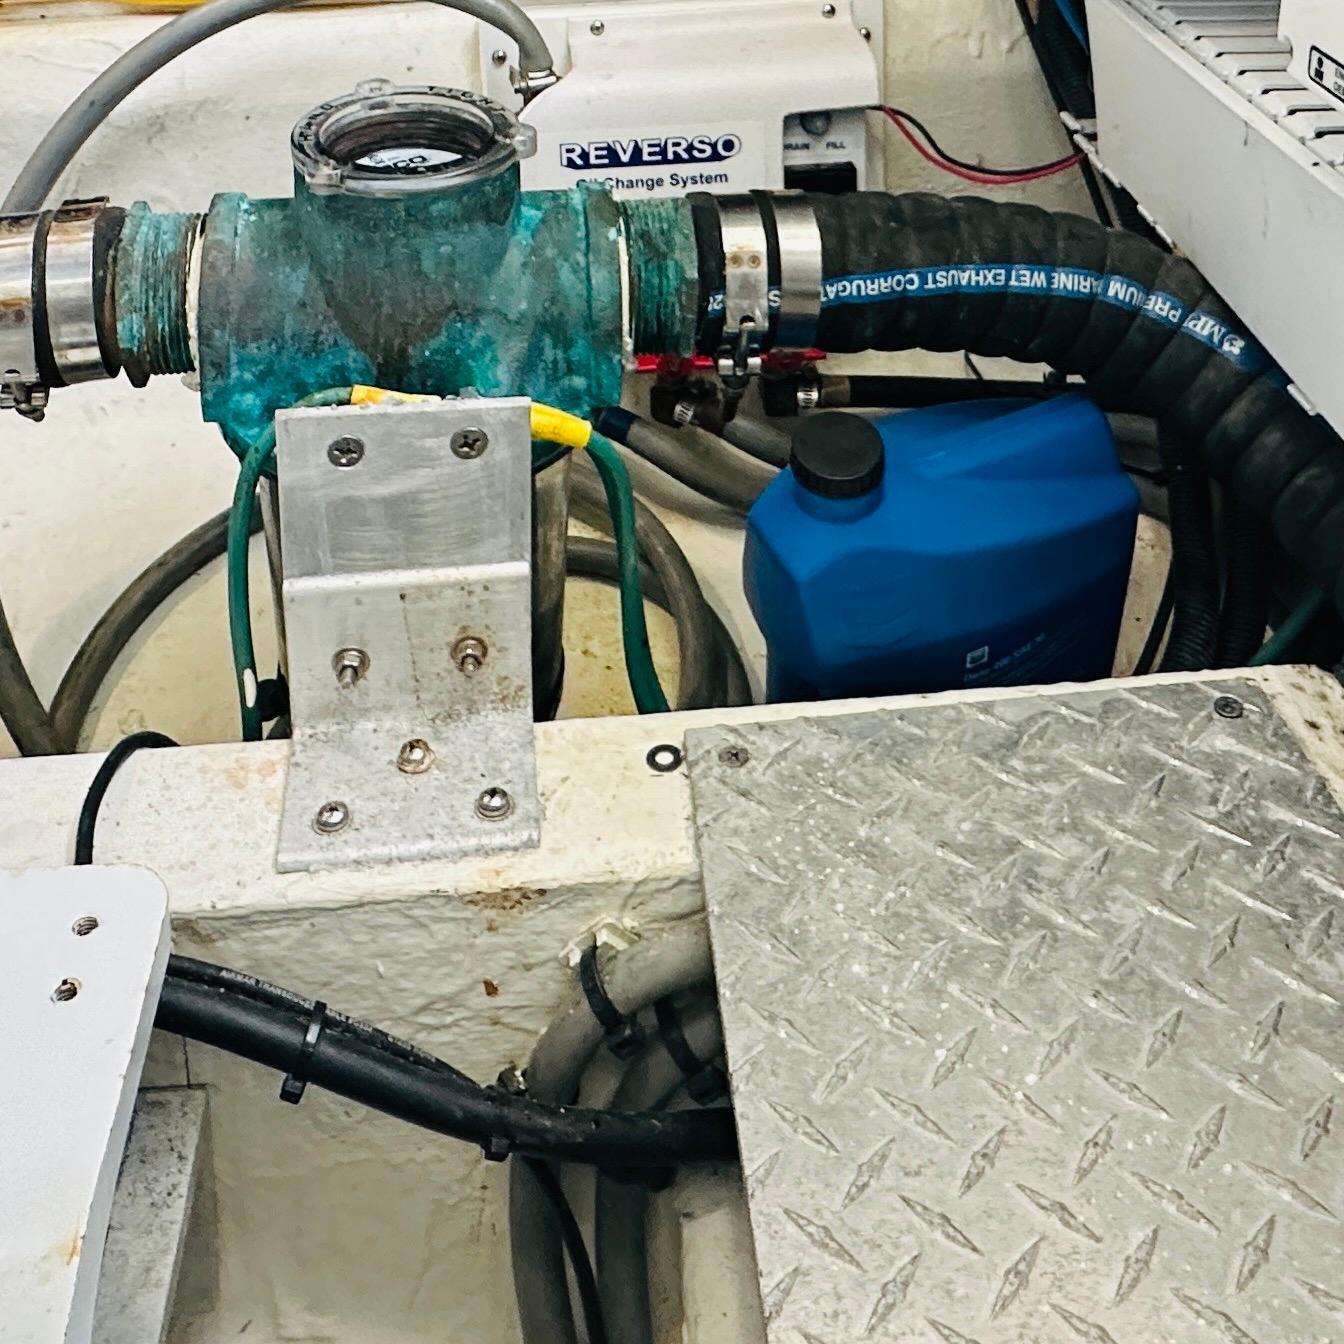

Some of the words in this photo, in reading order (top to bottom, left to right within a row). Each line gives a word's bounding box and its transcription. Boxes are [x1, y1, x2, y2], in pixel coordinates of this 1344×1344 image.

[560, 134, 742, 170] REVERSO
[669, 171, 729, 188] System
[821, 272, 920, 303] CORRUGAT
[925, 268, 1007, 291] EXHAUST
[1010, 268, 1047, 288] WET
[1108, 281, 1183, 324] PREIUM
